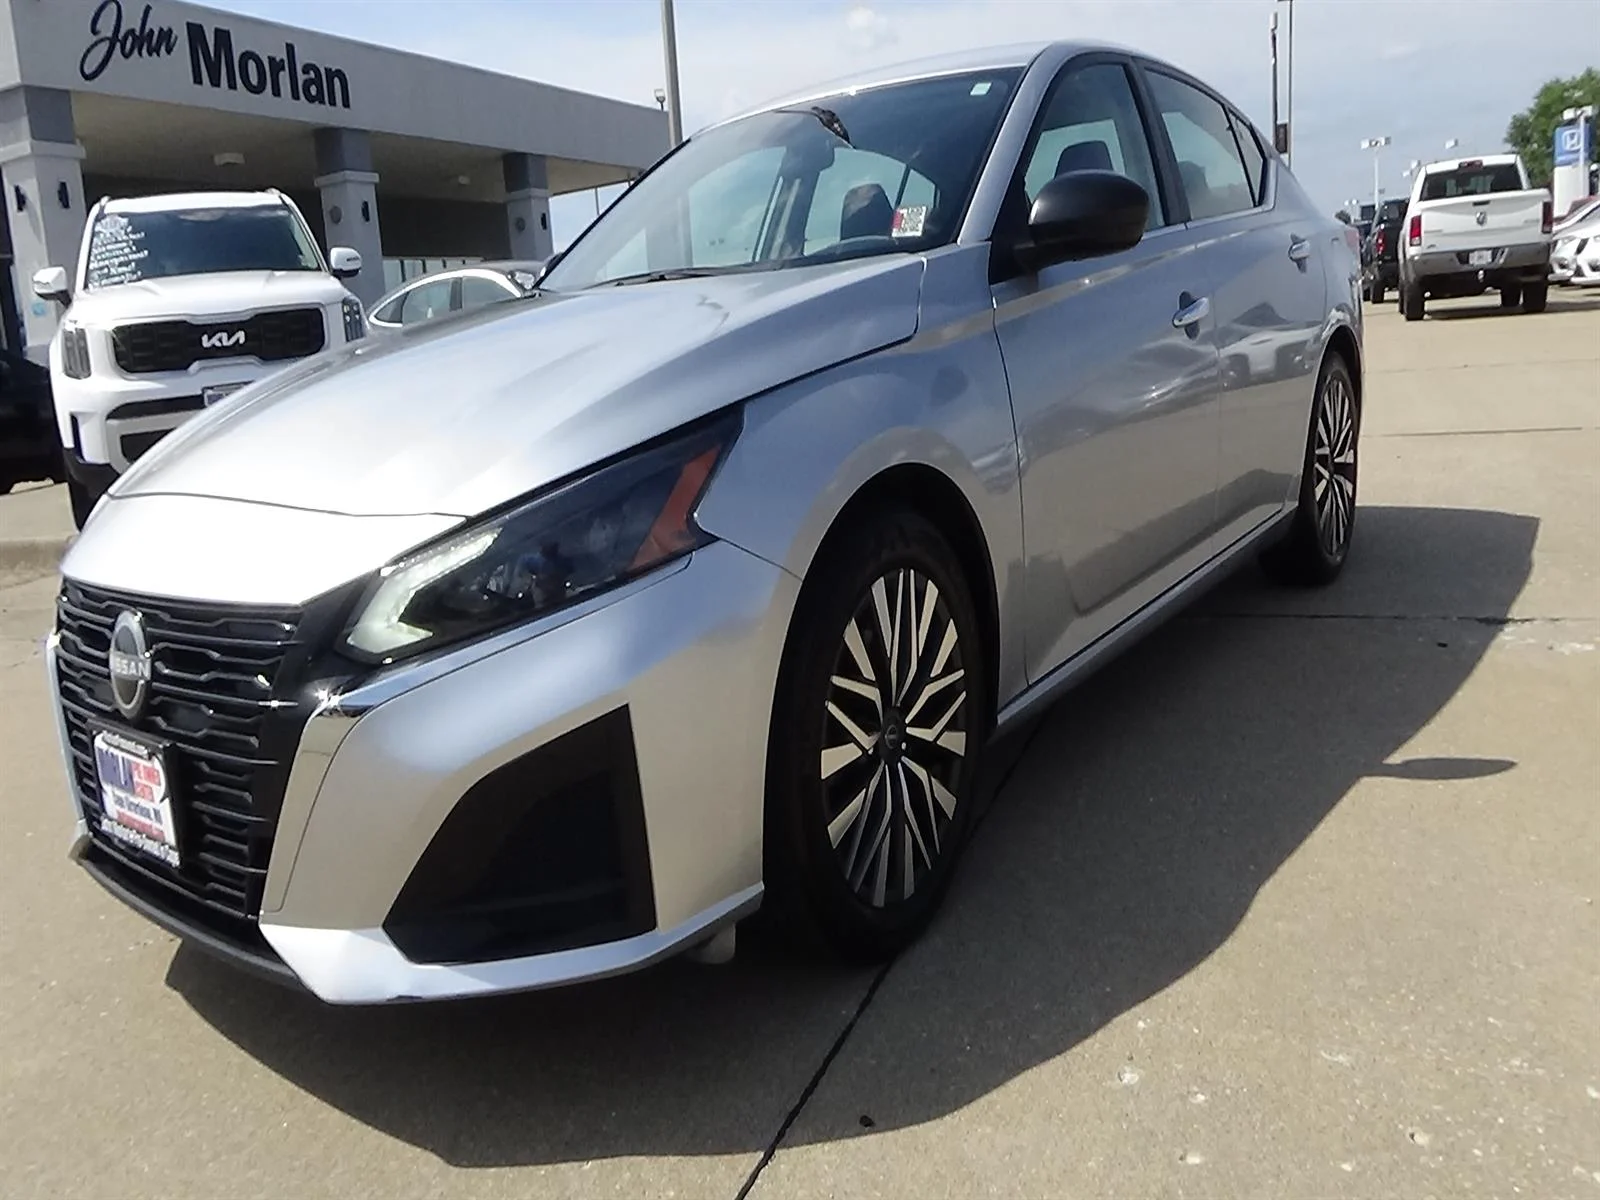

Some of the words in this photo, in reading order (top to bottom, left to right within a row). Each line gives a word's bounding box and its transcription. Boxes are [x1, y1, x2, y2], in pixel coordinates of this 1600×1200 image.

[80, 0, 178, 81] John
[186, 21, 351, 109] Morlan
[202, 330, 245, 348] KIA
[112, 656, 150, 679] SSAN
